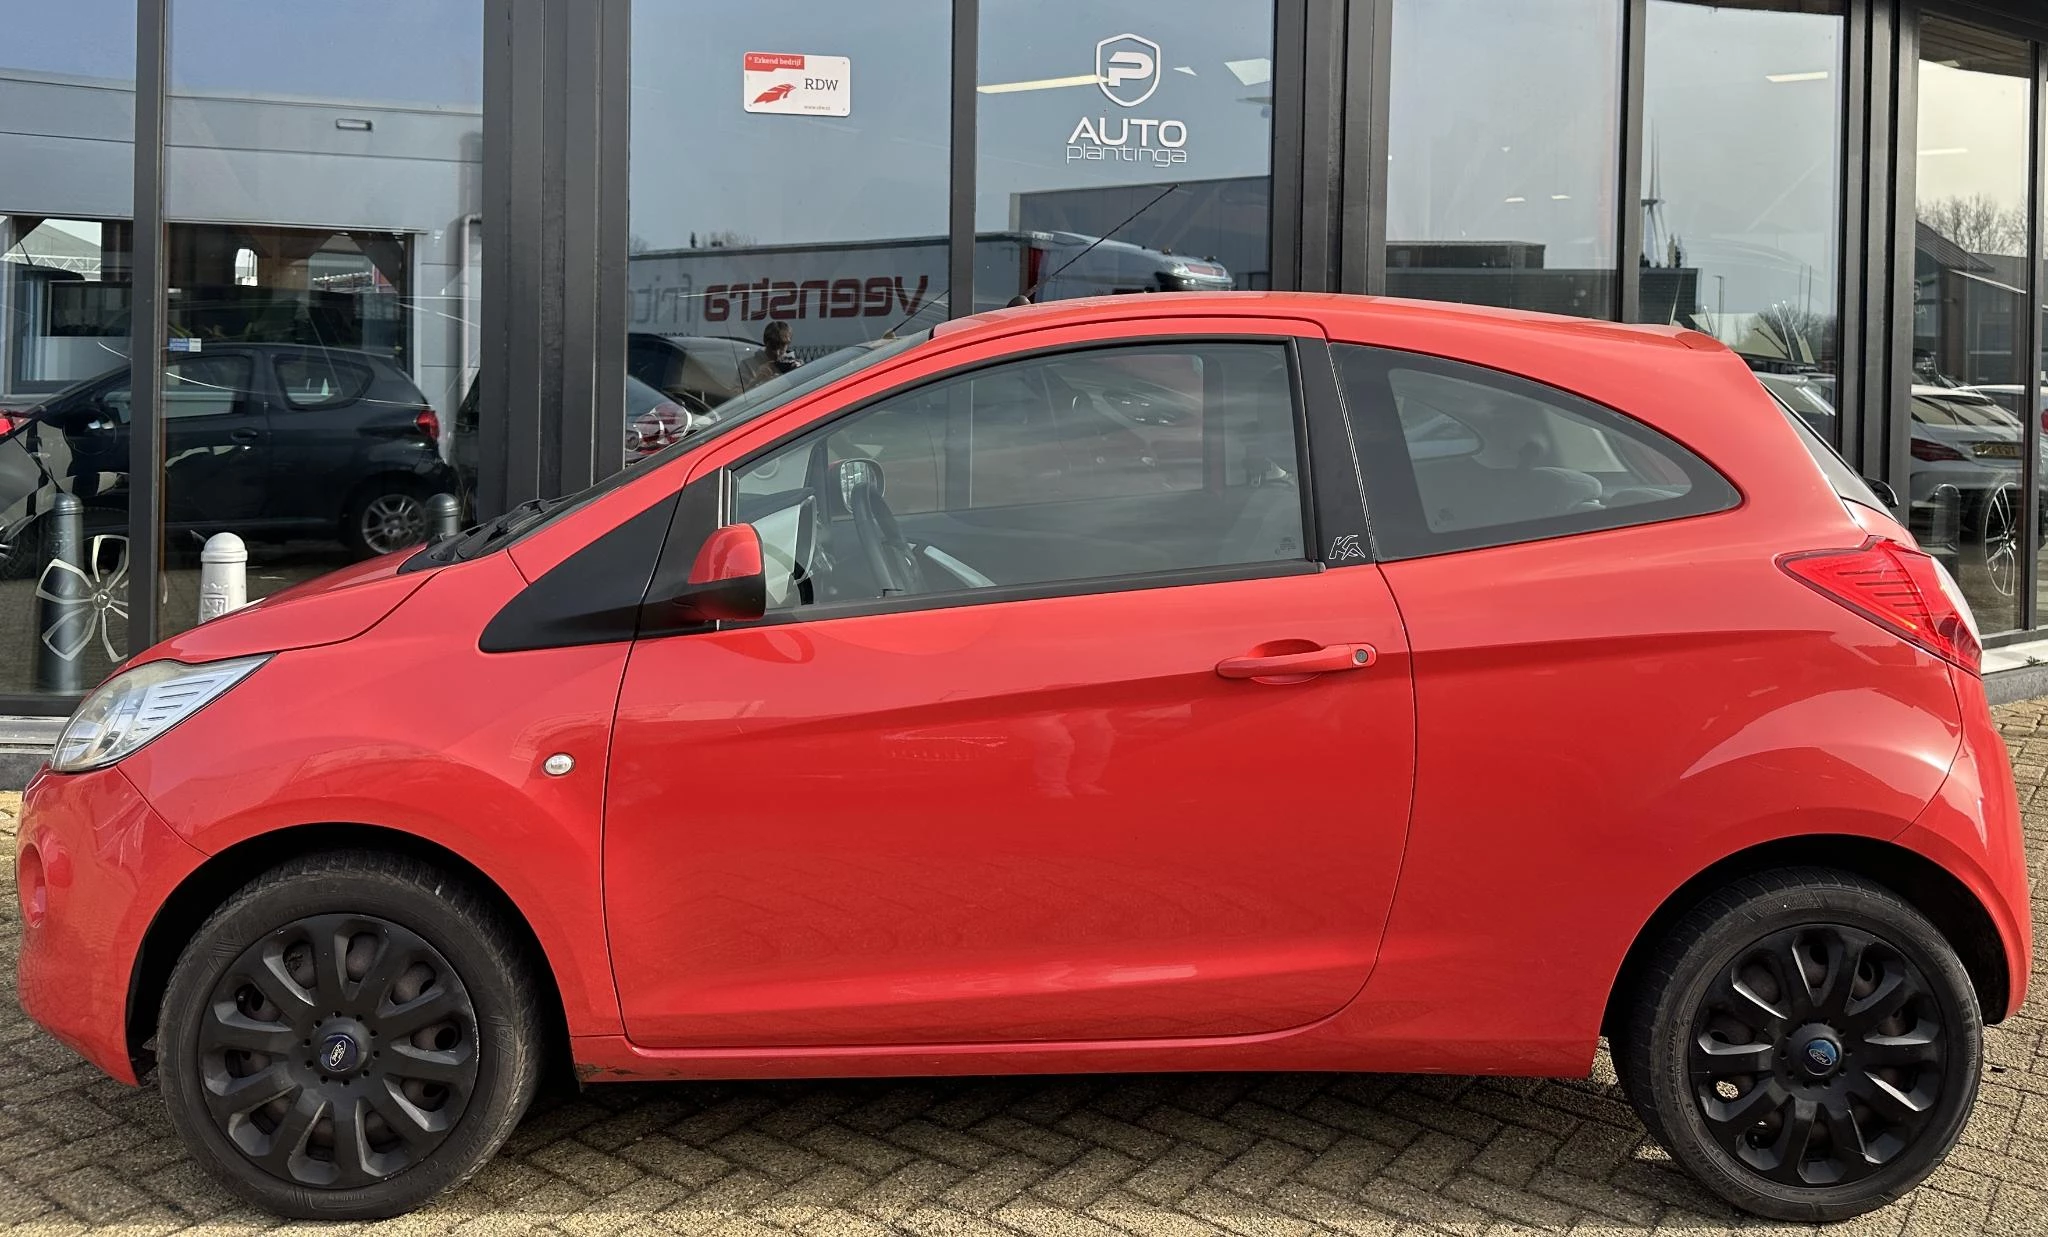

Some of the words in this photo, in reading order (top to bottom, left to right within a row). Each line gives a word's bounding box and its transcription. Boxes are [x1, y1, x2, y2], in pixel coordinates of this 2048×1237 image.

[753, 56, 779, 65] Erkend
[804, 78, 839, 92] RDW
[1067, 116, 1187, 148] AUTO
[1066, 143, 1187, 168] plantinga
